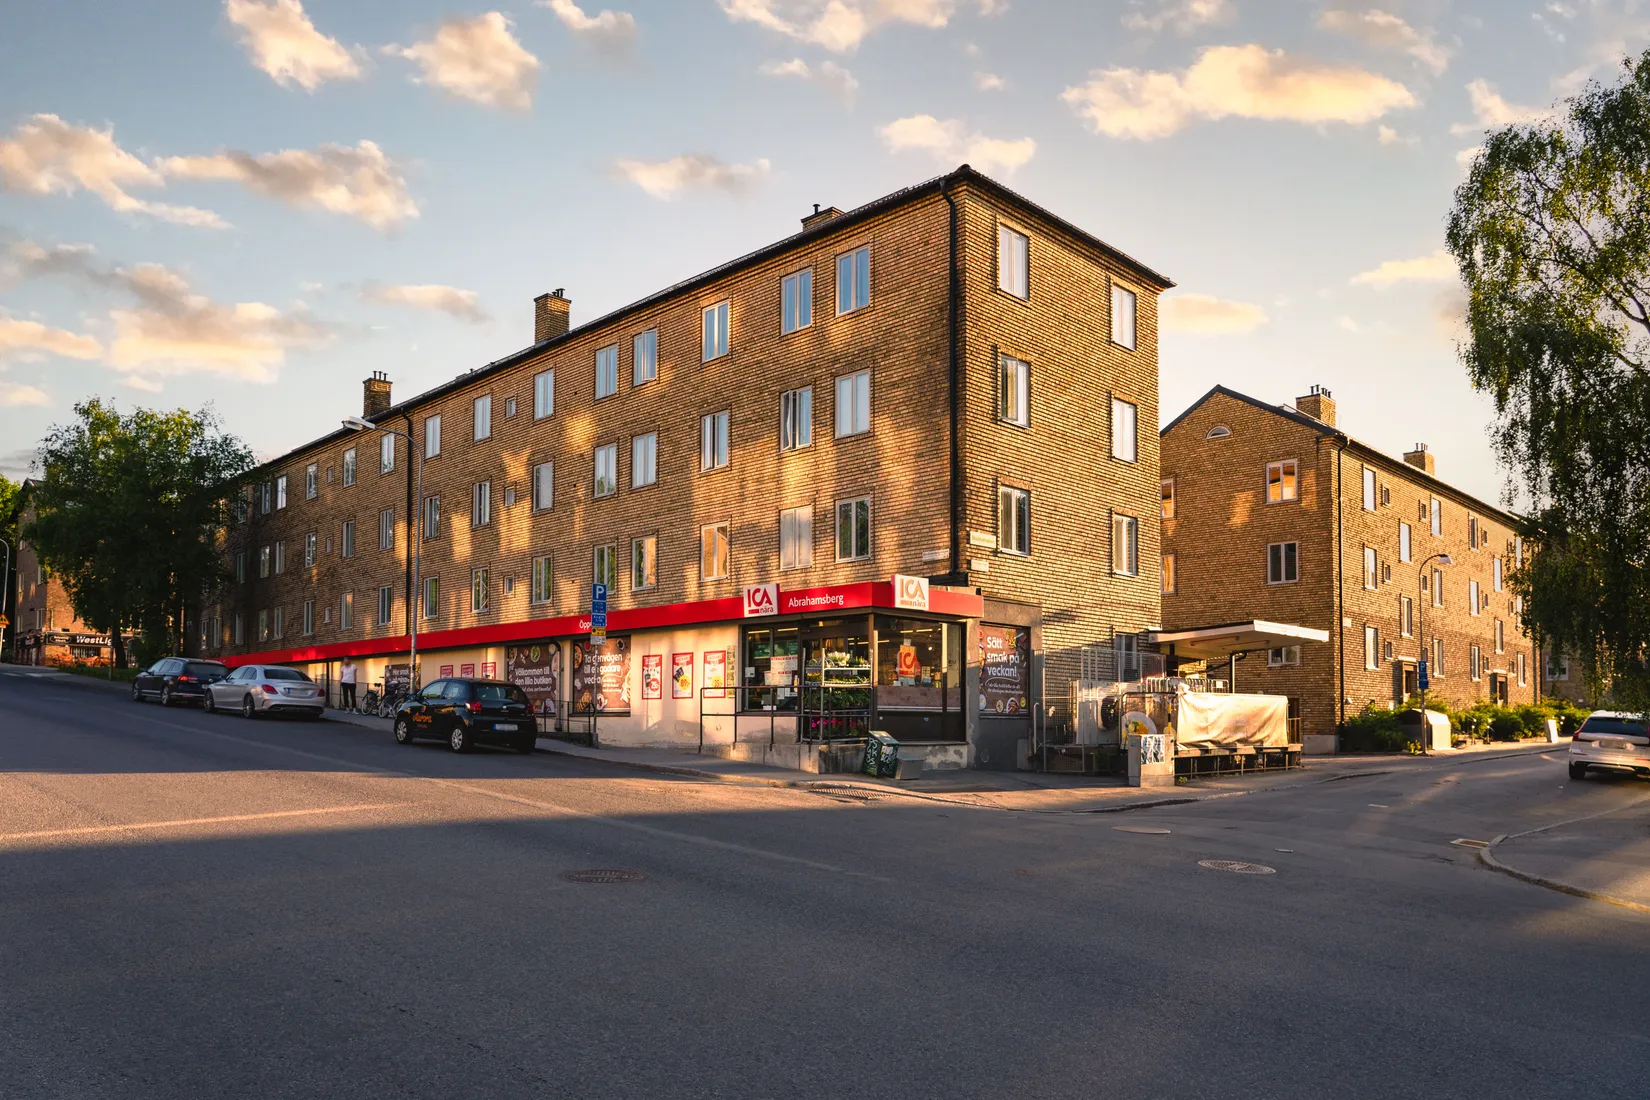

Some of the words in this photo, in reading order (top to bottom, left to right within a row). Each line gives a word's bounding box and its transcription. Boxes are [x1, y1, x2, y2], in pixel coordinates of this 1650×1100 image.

[596, 585, 605, 599] P
[902, 578, 926, 600] ICA
[747, 587, 773, 608] ICA
[788, 593, 844, 608] Abrahamsberg
[912, 599, 926, 608] nära
[760, 605, 774, 614] nära
[579, 619, 592, 631] Öpp
[76, 635, 112, 646] WestLig
[986, 636, 1003, 649] Sätt
[584, 654, 591, 663] Ta
[592, 652, 622, 664] gnvägen
[899, 652, 921, 669] ICA
[986, 651, 1008, 663] smak
[1009, 652, 1020, 666] på
[515, 667, 543, 676] Välkommen
[600, 664, 621, 675] godare
[987, 664, 1017, 677] veckan!
[515, 677, 525, 686] den
[534, 675, 552, 685] butiken
